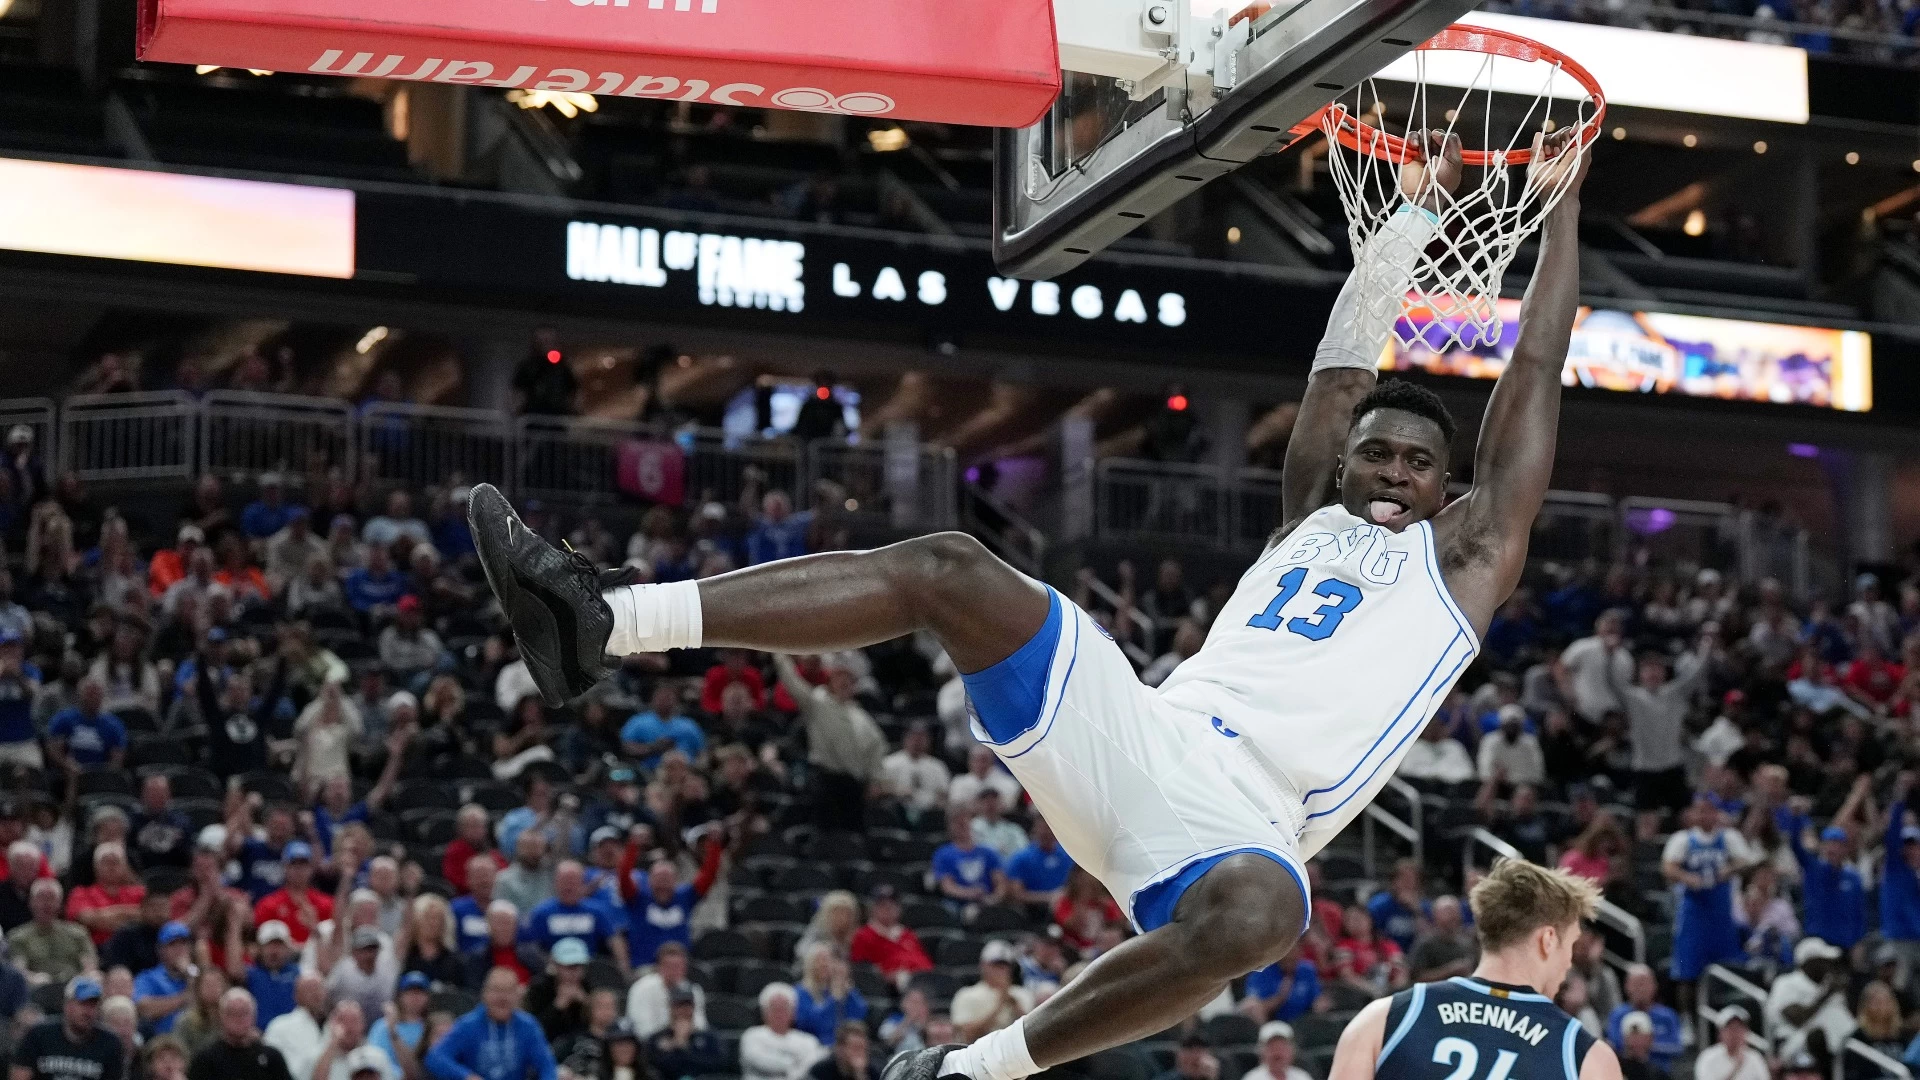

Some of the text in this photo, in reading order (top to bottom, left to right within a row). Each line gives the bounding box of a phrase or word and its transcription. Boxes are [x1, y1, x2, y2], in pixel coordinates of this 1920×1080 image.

[567, 221, 667, 287] HALL
[698, 234, 805, 298] FAME
[833, 262, 947, 305] LAS
[987, 276, 1186, 327] VEGAS
[1269, 524, 1408, 585] BYU
[1246, 567, 1363, 641] 13
[1437, 1001, 1549, 1047] BRENNAN
